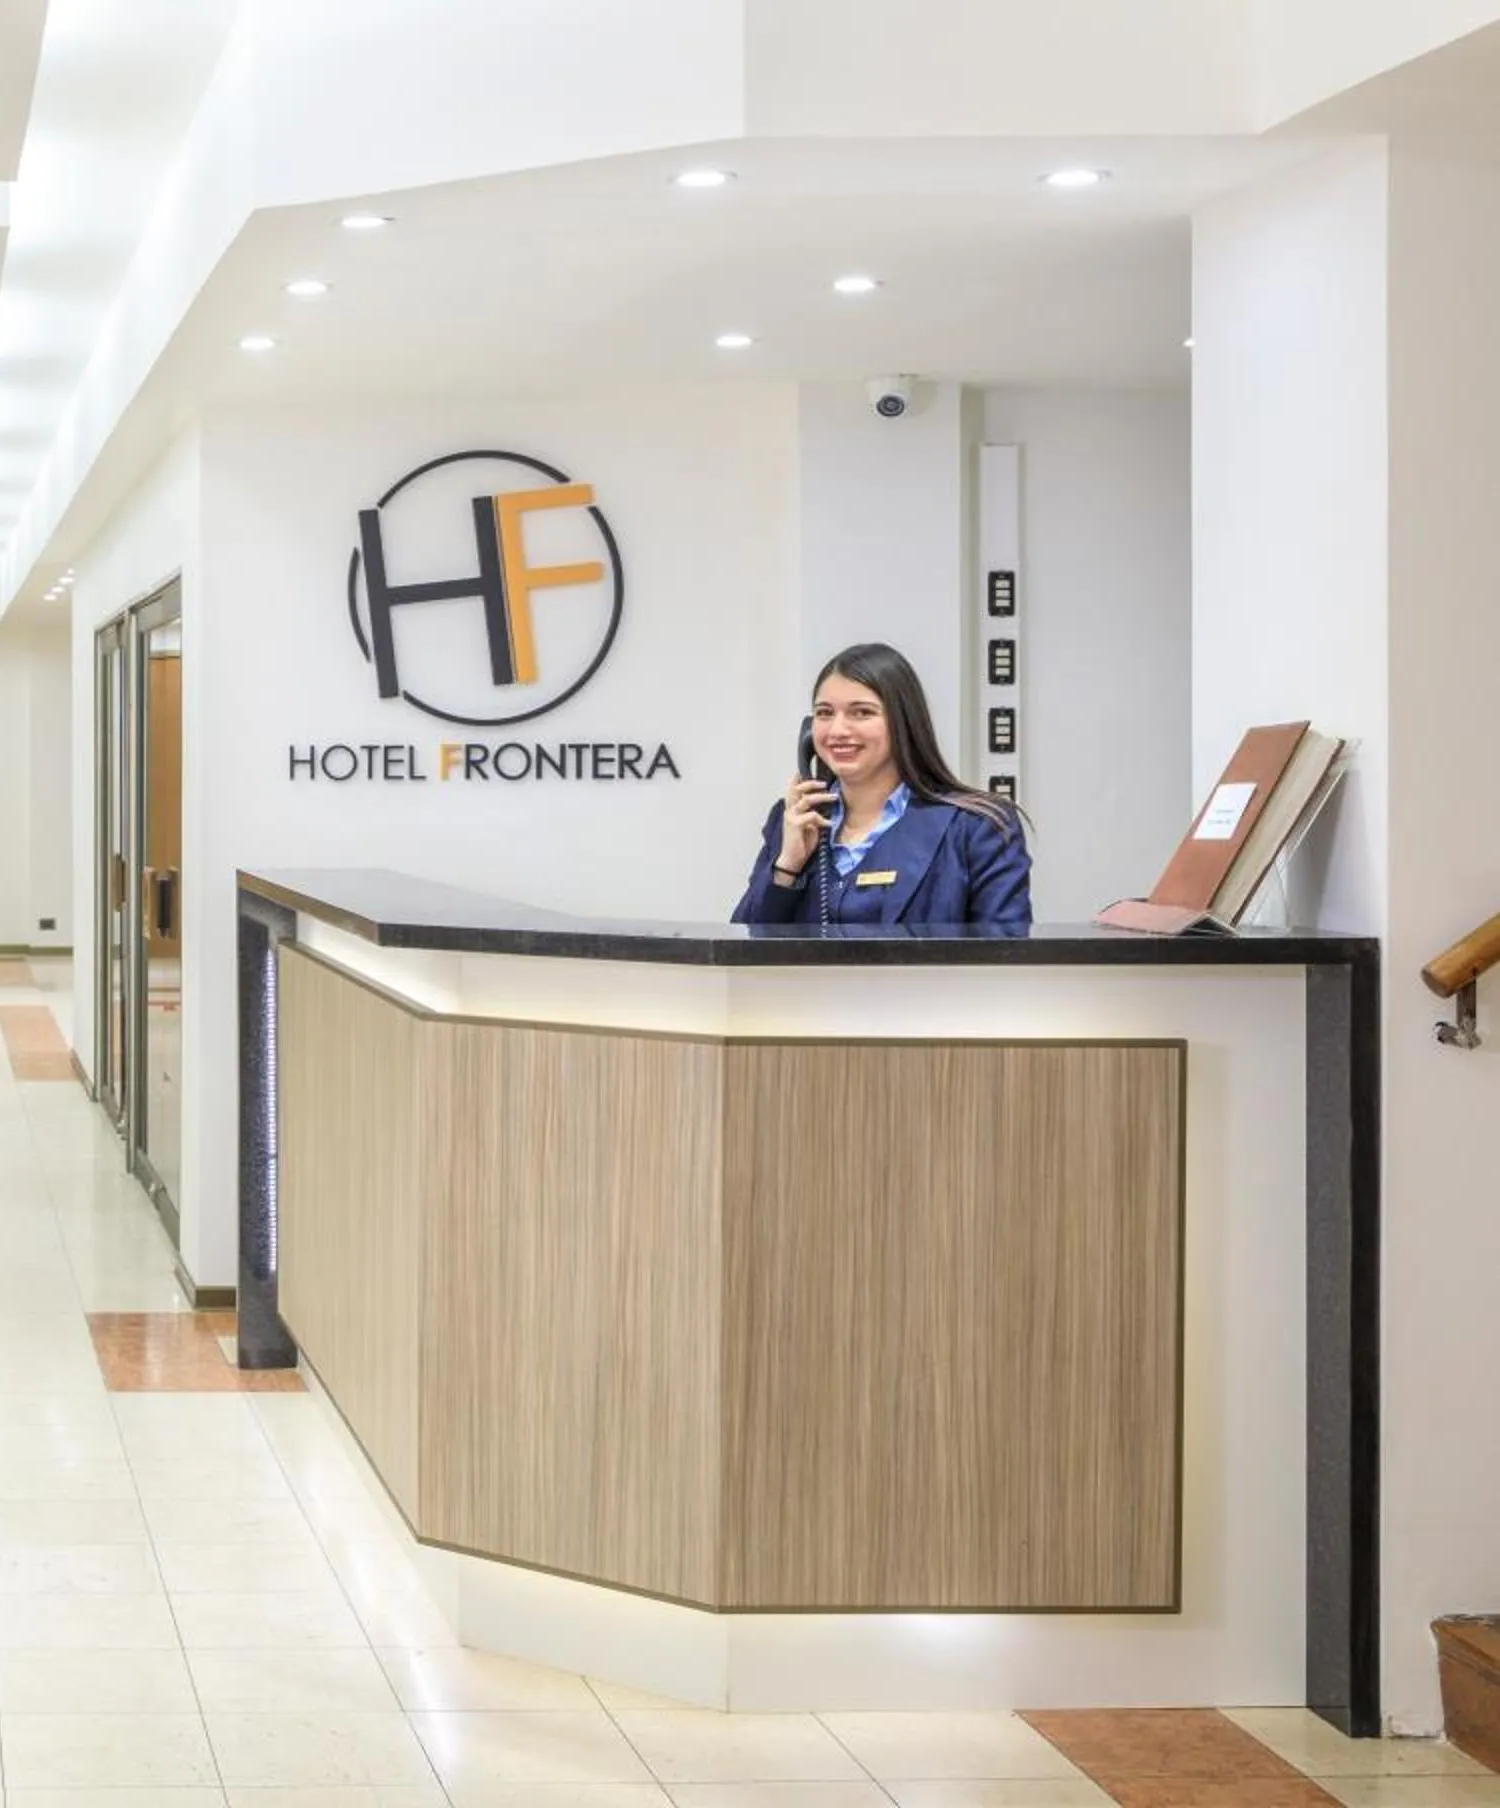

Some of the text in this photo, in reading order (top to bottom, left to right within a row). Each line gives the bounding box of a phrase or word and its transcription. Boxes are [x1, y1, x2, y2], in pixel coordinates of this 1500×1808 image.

[358, 483, 604, 699] HF
[289, 742, 681, 781] HOTEL FRONTERA
